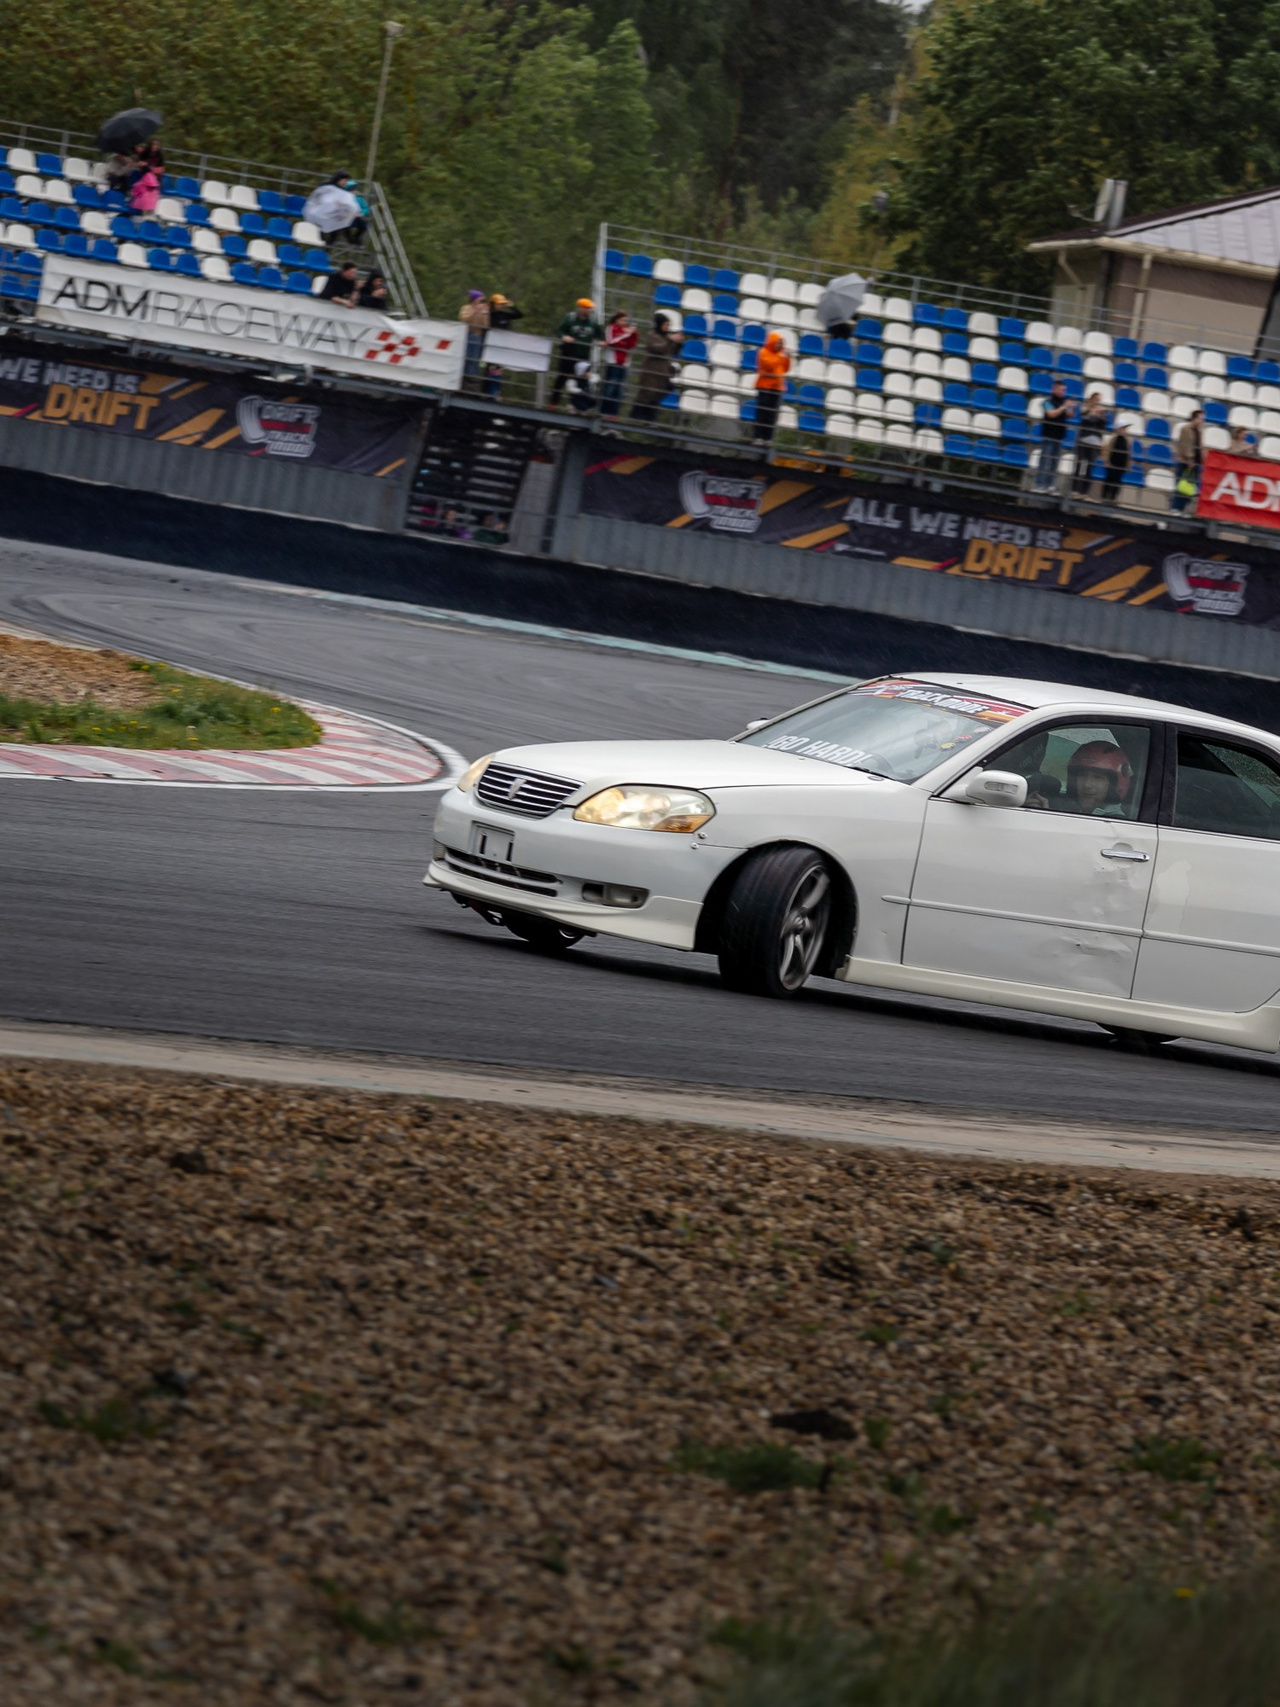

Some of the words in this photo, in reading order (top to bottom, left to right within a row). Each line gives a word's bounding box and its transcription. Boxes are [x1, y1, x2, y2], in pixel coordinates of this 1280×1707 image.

[52, 277, 371, 354] ADMRACEWAY
[42, 362, 110, 392] NEED
[113, 373, 139, 393] IS
[43, 382, 160, 430] DRIFT
[843, 497, 902, 528] ALL
[910, 507, 960, 538] WE
[963, 517, 1032, 546] NEED
[1036, 528, 1062, 549] IS
[963, 538, 1085, 585] DRIFT
